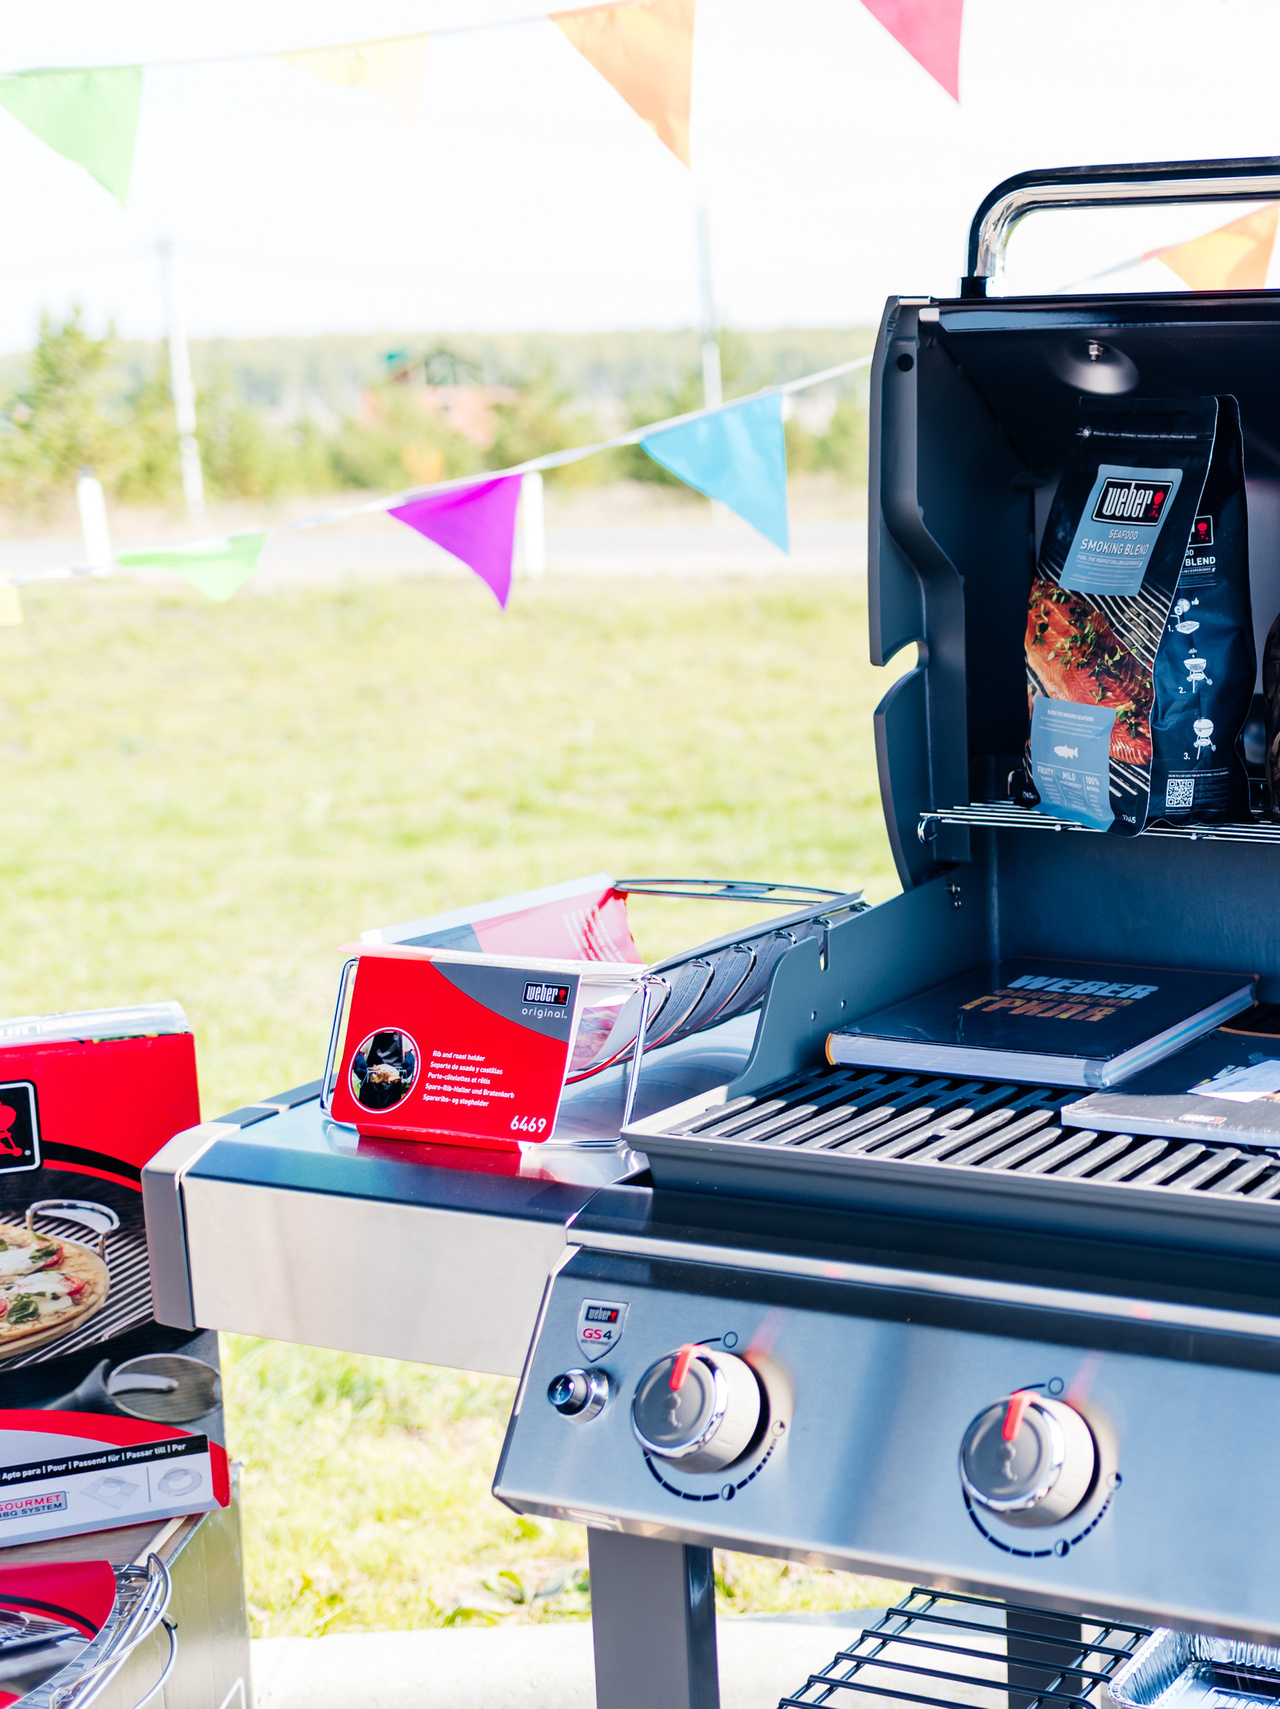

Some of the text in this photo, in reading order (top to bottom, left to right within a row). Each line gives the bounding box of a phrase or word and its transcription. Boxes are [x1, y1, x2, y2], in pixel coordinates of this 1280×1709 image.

[1102, 482, 1154, 518] weber
[1108, 530, 1139, 540] SEAFOOD
[1080, 538, 1150, 556] SMOKING BLEND
[1185, 556, 1216, 567] BLEND
[1184, 752, 1191, 760] 3.
[1038, 766, 1054, 777] FRUITY
[1062, 771, 1076, 781] MILD
[526, 984, 559, 1003] weber
[1006, 975, 1160, 1000] WEBER
[958, 996, 1118, 1022] ГРИЛЯ
[432, 1050, 441, 1058] Rib
[468, 1054, 486, 1062] holder
[430, 1061, 451, 1070] Soporte
[480, 1067, 503, 1075] costillas
[478, 1077, 491, 1085] rôtis
[425, 1082, 471, 1094] Spare-Rib-Halter
[483, 1089, 515, 1099] Bratenkorb
[422, 1094, 451, 1102] Spareribs-
[460, 1098, 490, 1107] stegholder
[510, 1115, 547, 1133] 6469
[588, 1306, 612, 1321] weber
[582, 1328, 613, 1341] GS4
[2, 1443, 187, 1481] Apto para Pour Passend für Passar till Per
[22, 1503, 63, 1515] SYSTEM
